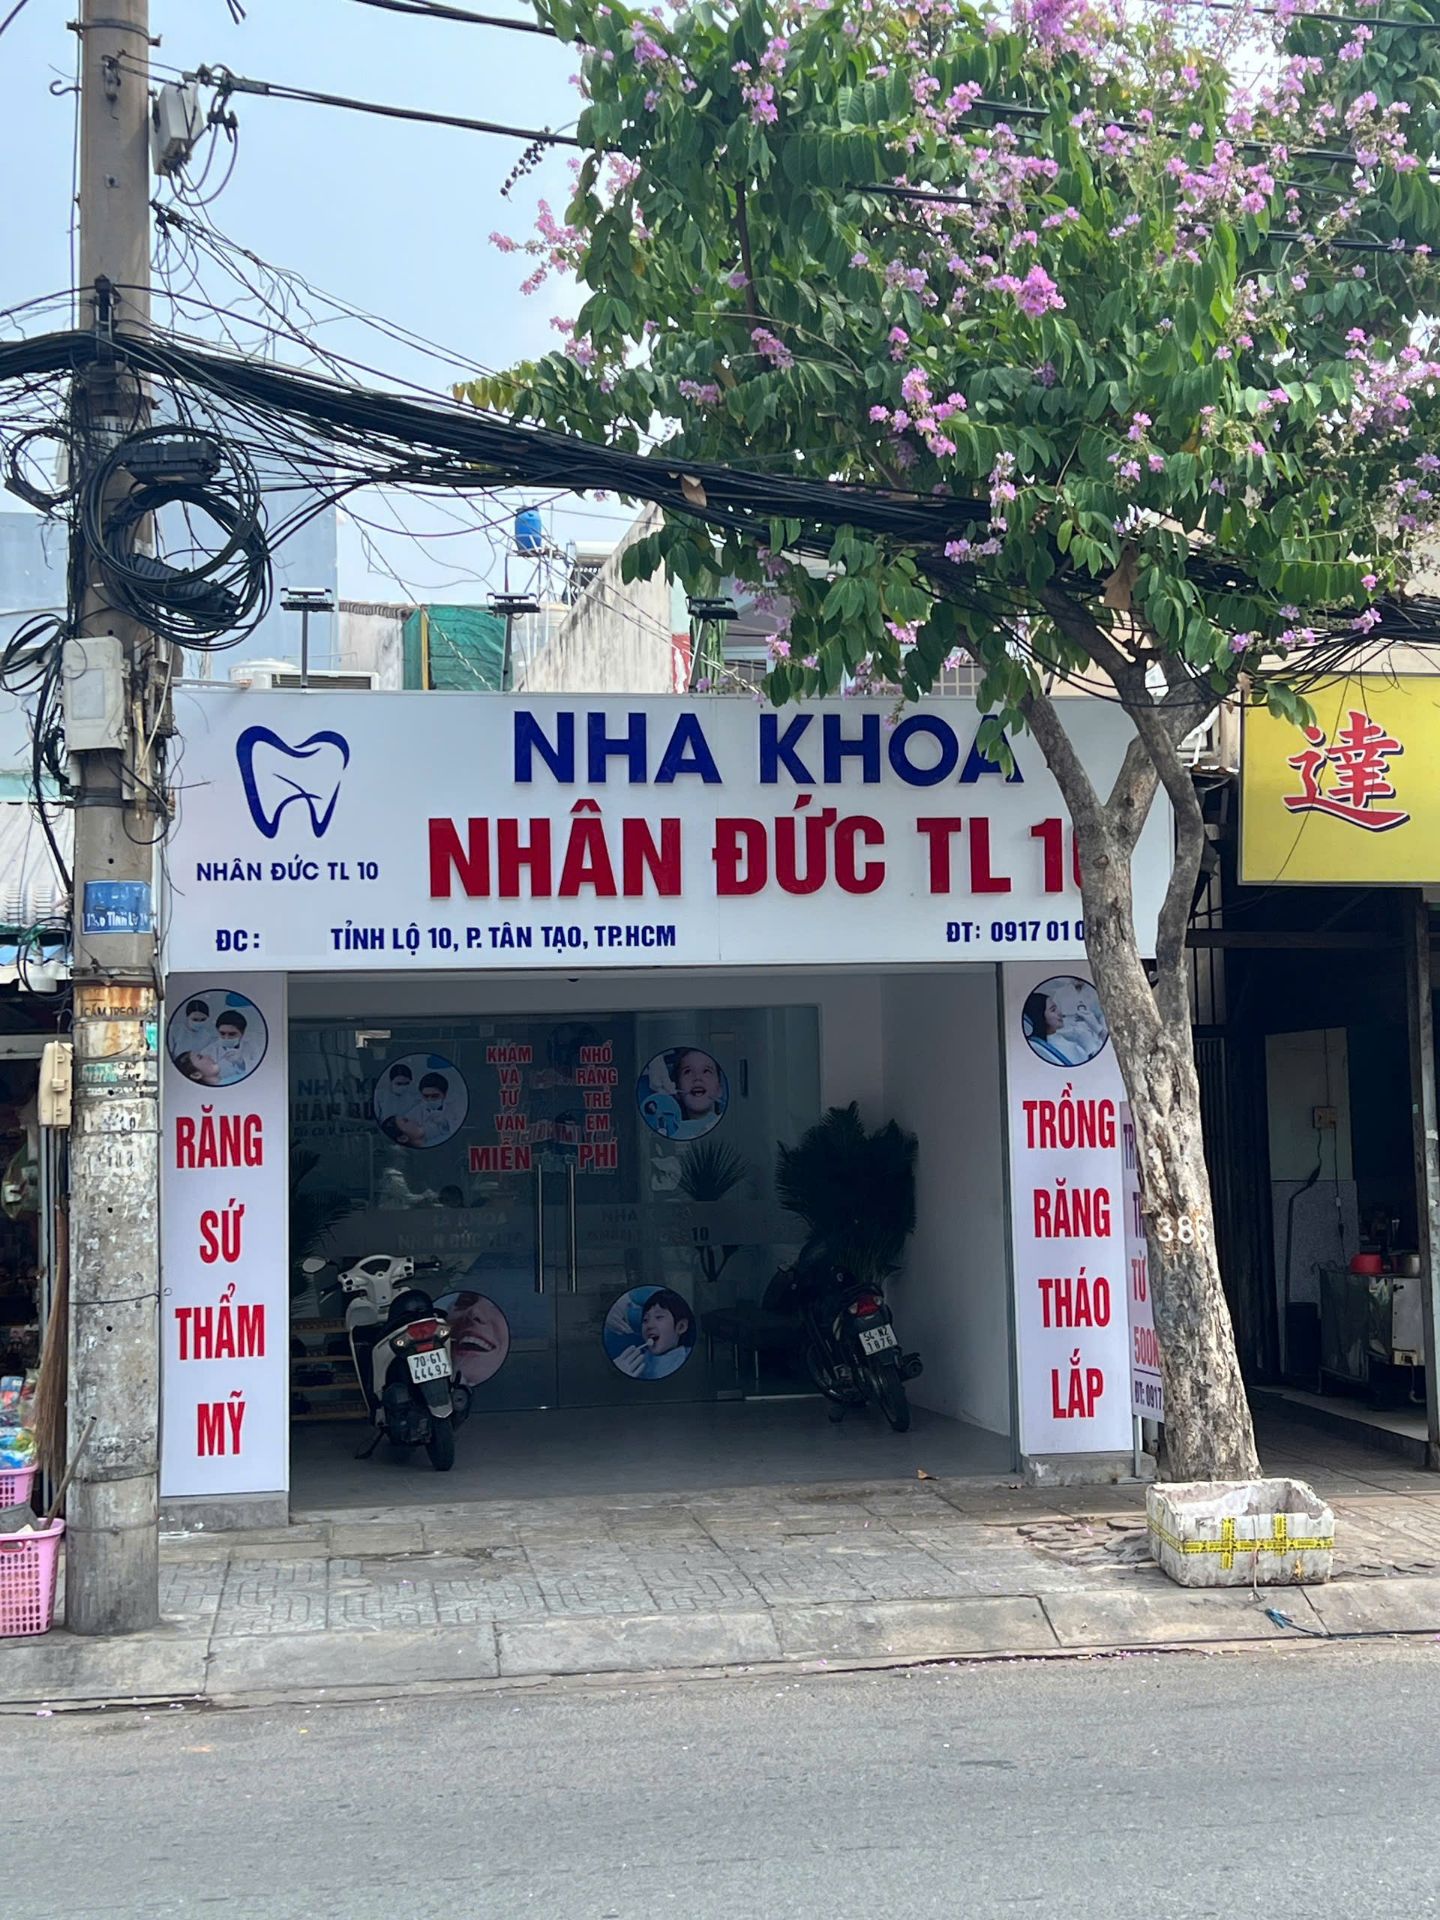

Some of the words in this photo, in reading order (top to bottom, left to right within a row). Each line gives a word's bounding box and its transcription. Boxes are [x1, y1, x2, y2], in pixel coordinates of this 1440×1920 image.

[514, 710, 722, 785] NHA
[758, 713, 1024, 786] KHOA
[196, 857, 262, 881] NHÂN
[270, 853, 319, 881] ĐỨC
[327, 862, 350, 880] TL
[357, 862, 379, 881] 10
[428, 798, 682, 897] NHÂN
[711, 794, 886, 896] ĐỨC
[916, 817, 1011, 893] TL
[1031, 818, 1082, 893] 1
[331, 919, 385, 950] TỈNH
[392, 922, 421, 956] LỘ
[427, 927, 459, 952] 10,
[488, 921, 532, 948] TÂN
[541, 926, 588, 953] TẠO,
[594, 925, 676, 947] TP.HCM
[946, 921, 981, 943] ĐT:
[991, 921, 1041, 943] 0917
[176, 1104, 263, 1169] RĂNG
[587, 1114, 609, 1130] EM
[1022, 1083, 1116, 1149] TRỒNG
[469, 1137, 530, 1172] MIỄN
[579, 1137, 617, 1168] PHÍ
[199, 1197, 245, 1264] SỨ
[1033, 1178, 1111, 1239] RĂNG
[175, 1282, 265, 1360] THẨM
[1038, 1266, 1111, 1328] THÁO
[1051, 1349, 1104, 1419] LẮP
[197, 1390, 246, 1457] MỸ
